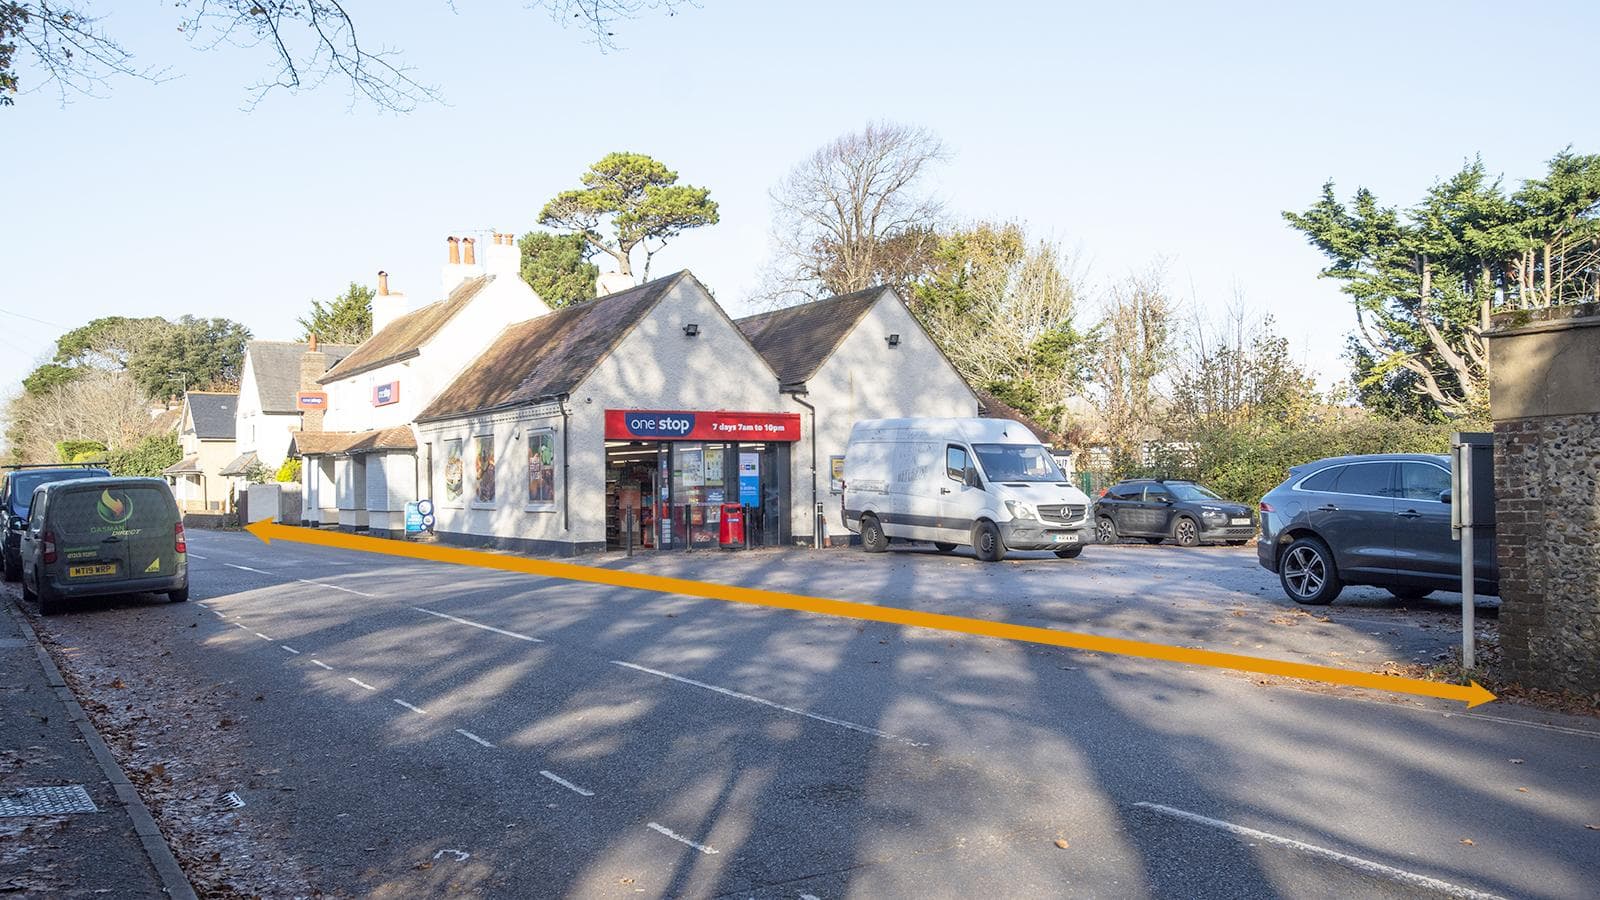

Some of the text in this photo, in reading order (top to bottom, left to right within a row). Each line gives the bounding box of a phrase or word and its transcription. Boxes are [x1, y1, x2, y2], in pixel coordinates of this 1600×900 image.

[631, 417, 690, 434] one stop
[712, 423, 718, 431] 7
[718, 423, 737, 433] days
[754, 424, 763, 432] to
[764, 423, 785, 433] 10pm
[111, 528, 142, 537] DIRECT
